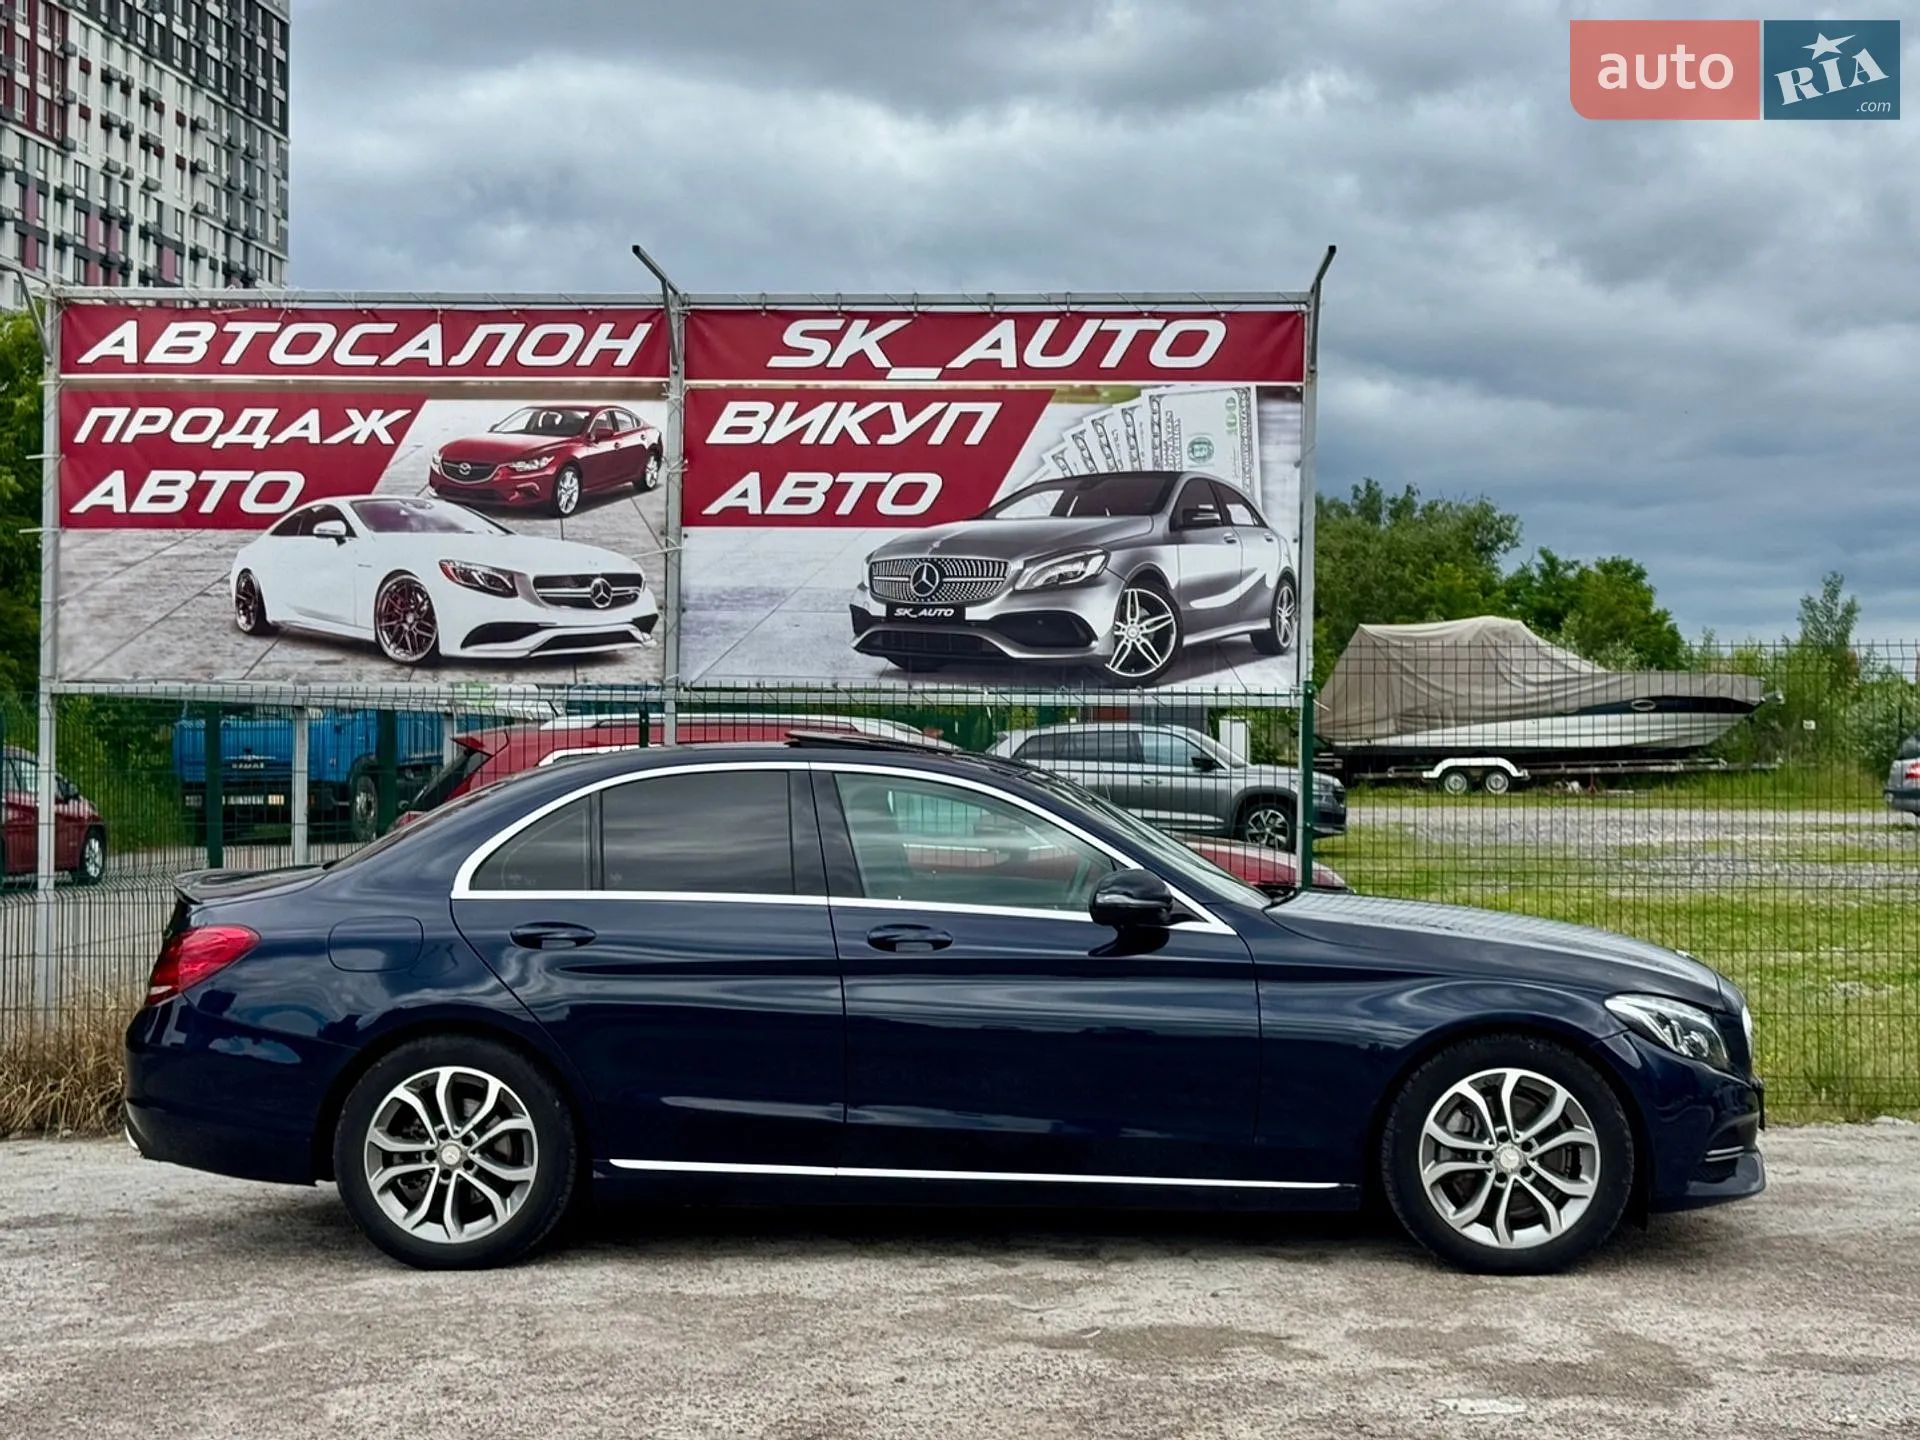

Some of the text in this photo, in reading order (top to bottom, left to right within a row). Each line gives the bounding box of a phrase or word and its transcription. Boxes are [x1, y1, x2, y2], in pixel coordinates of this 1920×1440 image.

[76, 319, 653, 367] АВТОСАЛОН
[765, 318, 1228, 380] SK_AUTO
[72, 406, 412, 450] ПРОДАЖ
[704, 400, 1003, 446] ВИКУП
[69, 469, 306, 514] АВТО
[701, 470, 944, 516] АВТО
[893, 607, 955, 618] SK_AUTO
